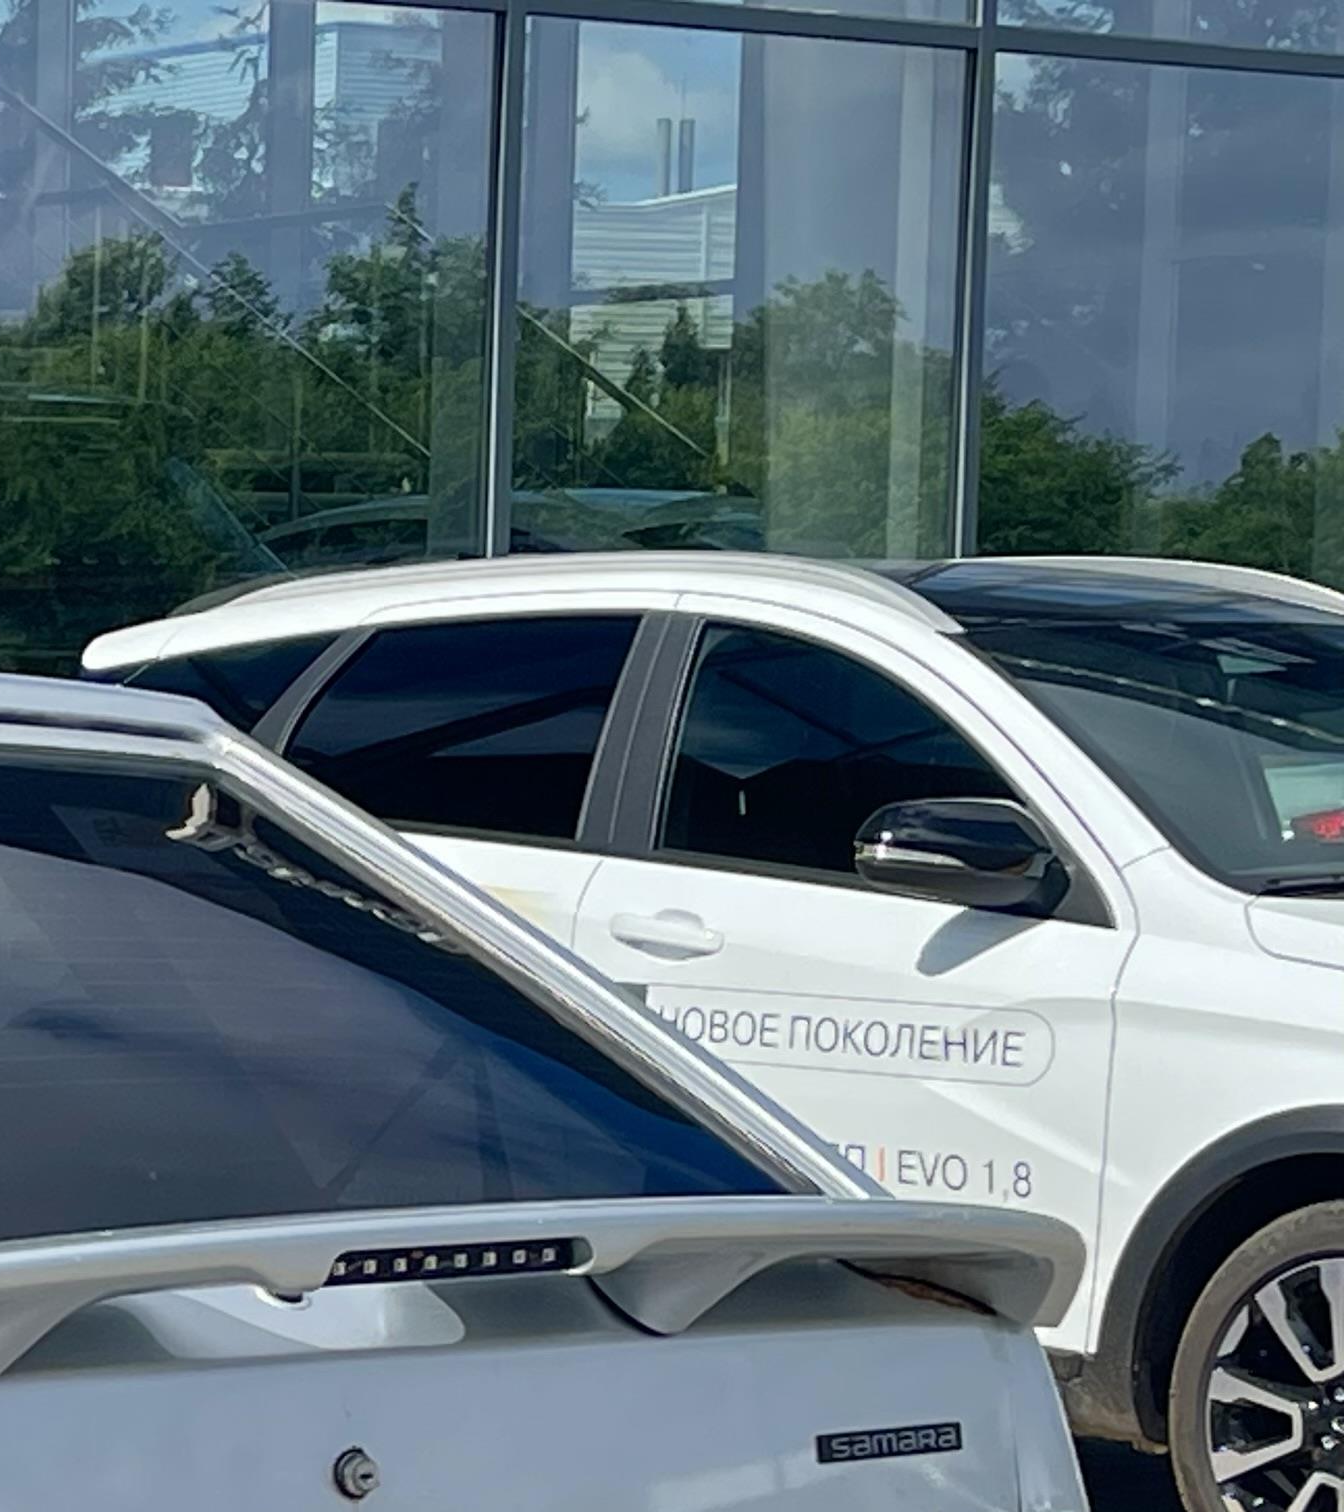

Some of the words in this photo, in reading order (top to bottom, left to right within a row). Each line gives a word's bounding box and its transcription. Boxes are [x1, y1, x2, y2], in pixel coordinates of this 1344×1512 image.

[788, 1015, 1027, 1068] ПОКОЛЕНИЕ
[897, 1149, 968, 1192] EVO
[982, 1160, 1032, 1203] 1,8
